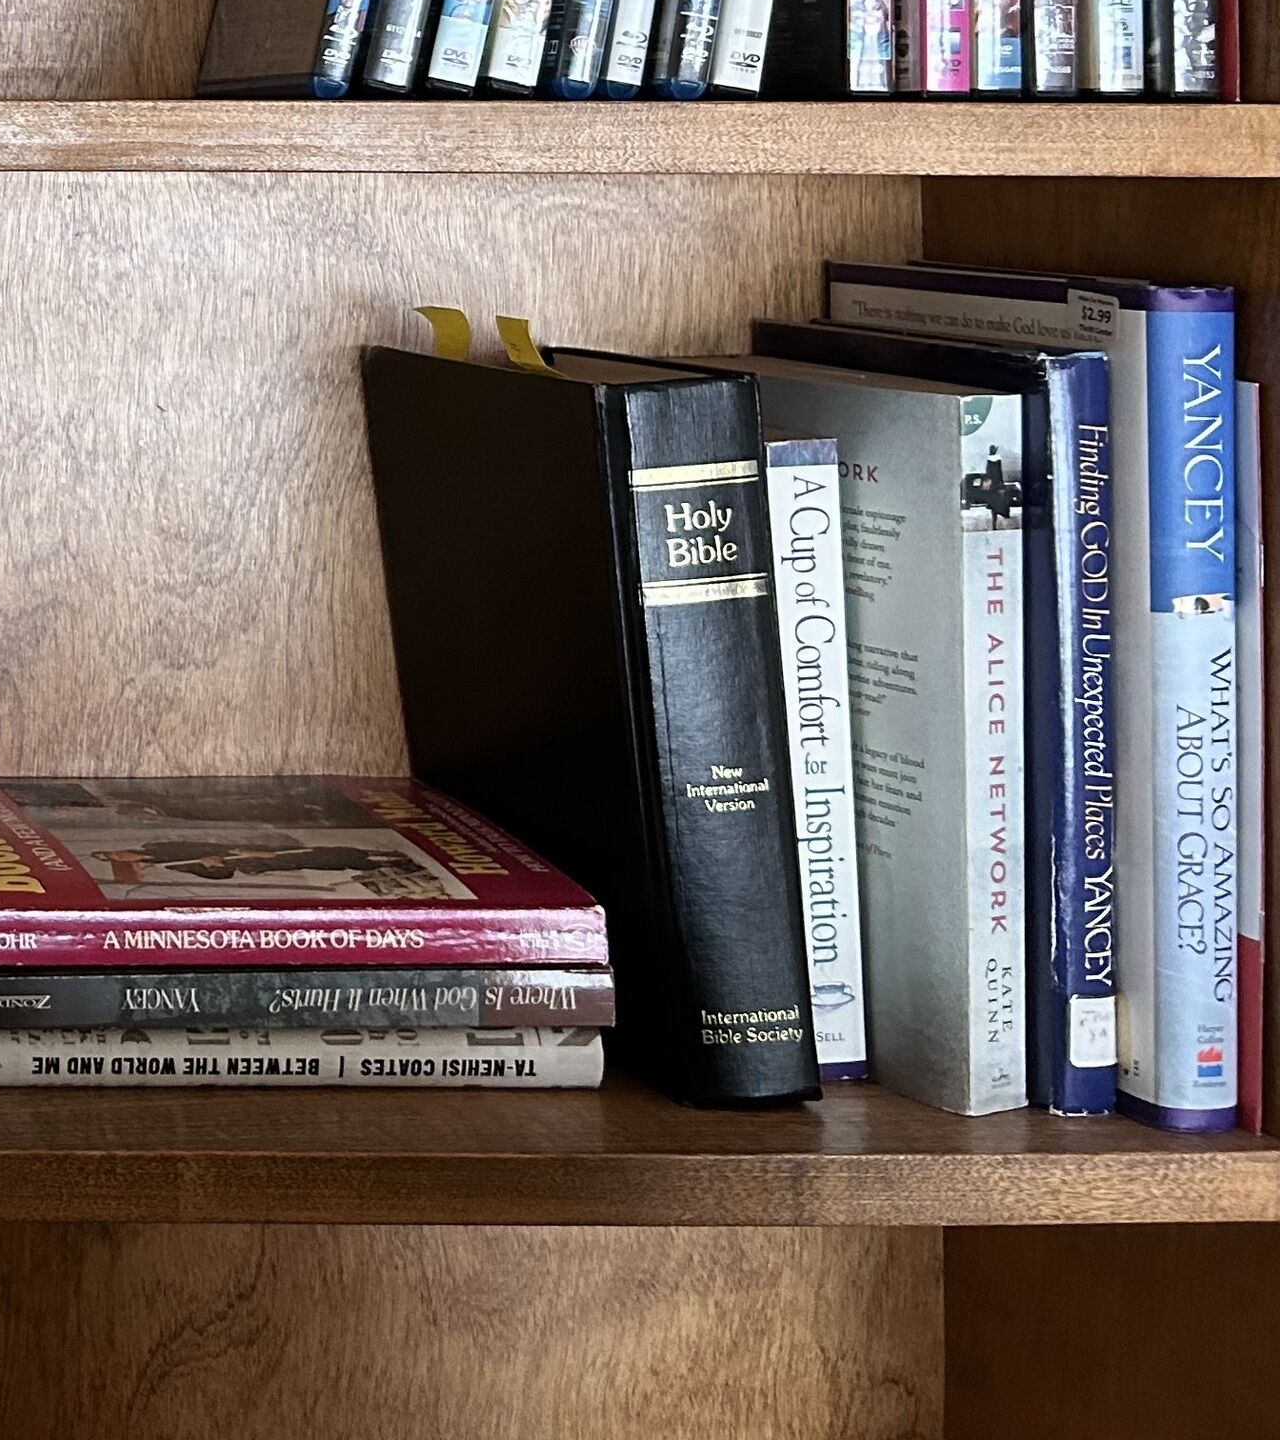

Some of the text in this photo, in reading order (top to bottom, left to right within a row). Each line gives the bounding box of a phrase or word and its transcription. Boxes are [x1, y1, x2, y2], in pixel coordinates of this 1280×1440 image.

[729, 51, 761, 62] DVD
[960, 312, 974, 330] do
[1013, 316, 1036, 337] God
[1037, 321, 1060, 340] love
[1081, 305, 1112, 324] $2.99
[1073, 423, 1110, 515] Finding
[1182, 344, 1225, 564] YANCEY
[663, 499, 733, 533] Holy
[665, 534, 738, 568] Bible
[1080, 521, 1110, 603] GOD
[1082, 607, 1111, 630] In
[780, 475, 849, 967] A Cup of Comfort for Inspiration
[1073, 633, 1113, 778] Unexpected
[986, 547, 1008, 935] THE ALICE NETWORK
[686, 777, 770, 799] International
[710, 765, 743, 780] New
[704, 798, 756, 813] Version
[1083, 785, 1114, 861] Places
[1175, 703, 1209, 957] ABOUT GRACE?
[1209, 646, 1236, 1003] WHAT'S SO AMAZING
[31, 846, 74, 872] (AND
[395, 821, 510, 876] Howard
[102, 929, 425, 950] A MINNESOTA BOOK OF DAYS
[1083, 865, 1115, 986] YANCEY
[122, 988, 201, 1013] YANCEY
[268, 985, 577, 1014] Where Is God When It Hurts?
[985, 958, 999, 1044] QUINN
[1001, 965, 1014, 1032] KATE
[701, 1005, 800, 1025] International
[701, 1026, 804, 1045] Bible Society
[31, 1056, 320, 1076] BETWEEN THE WORLD AND ME
[359, 1059, 537, 1077] TA-NEHISI COATES
